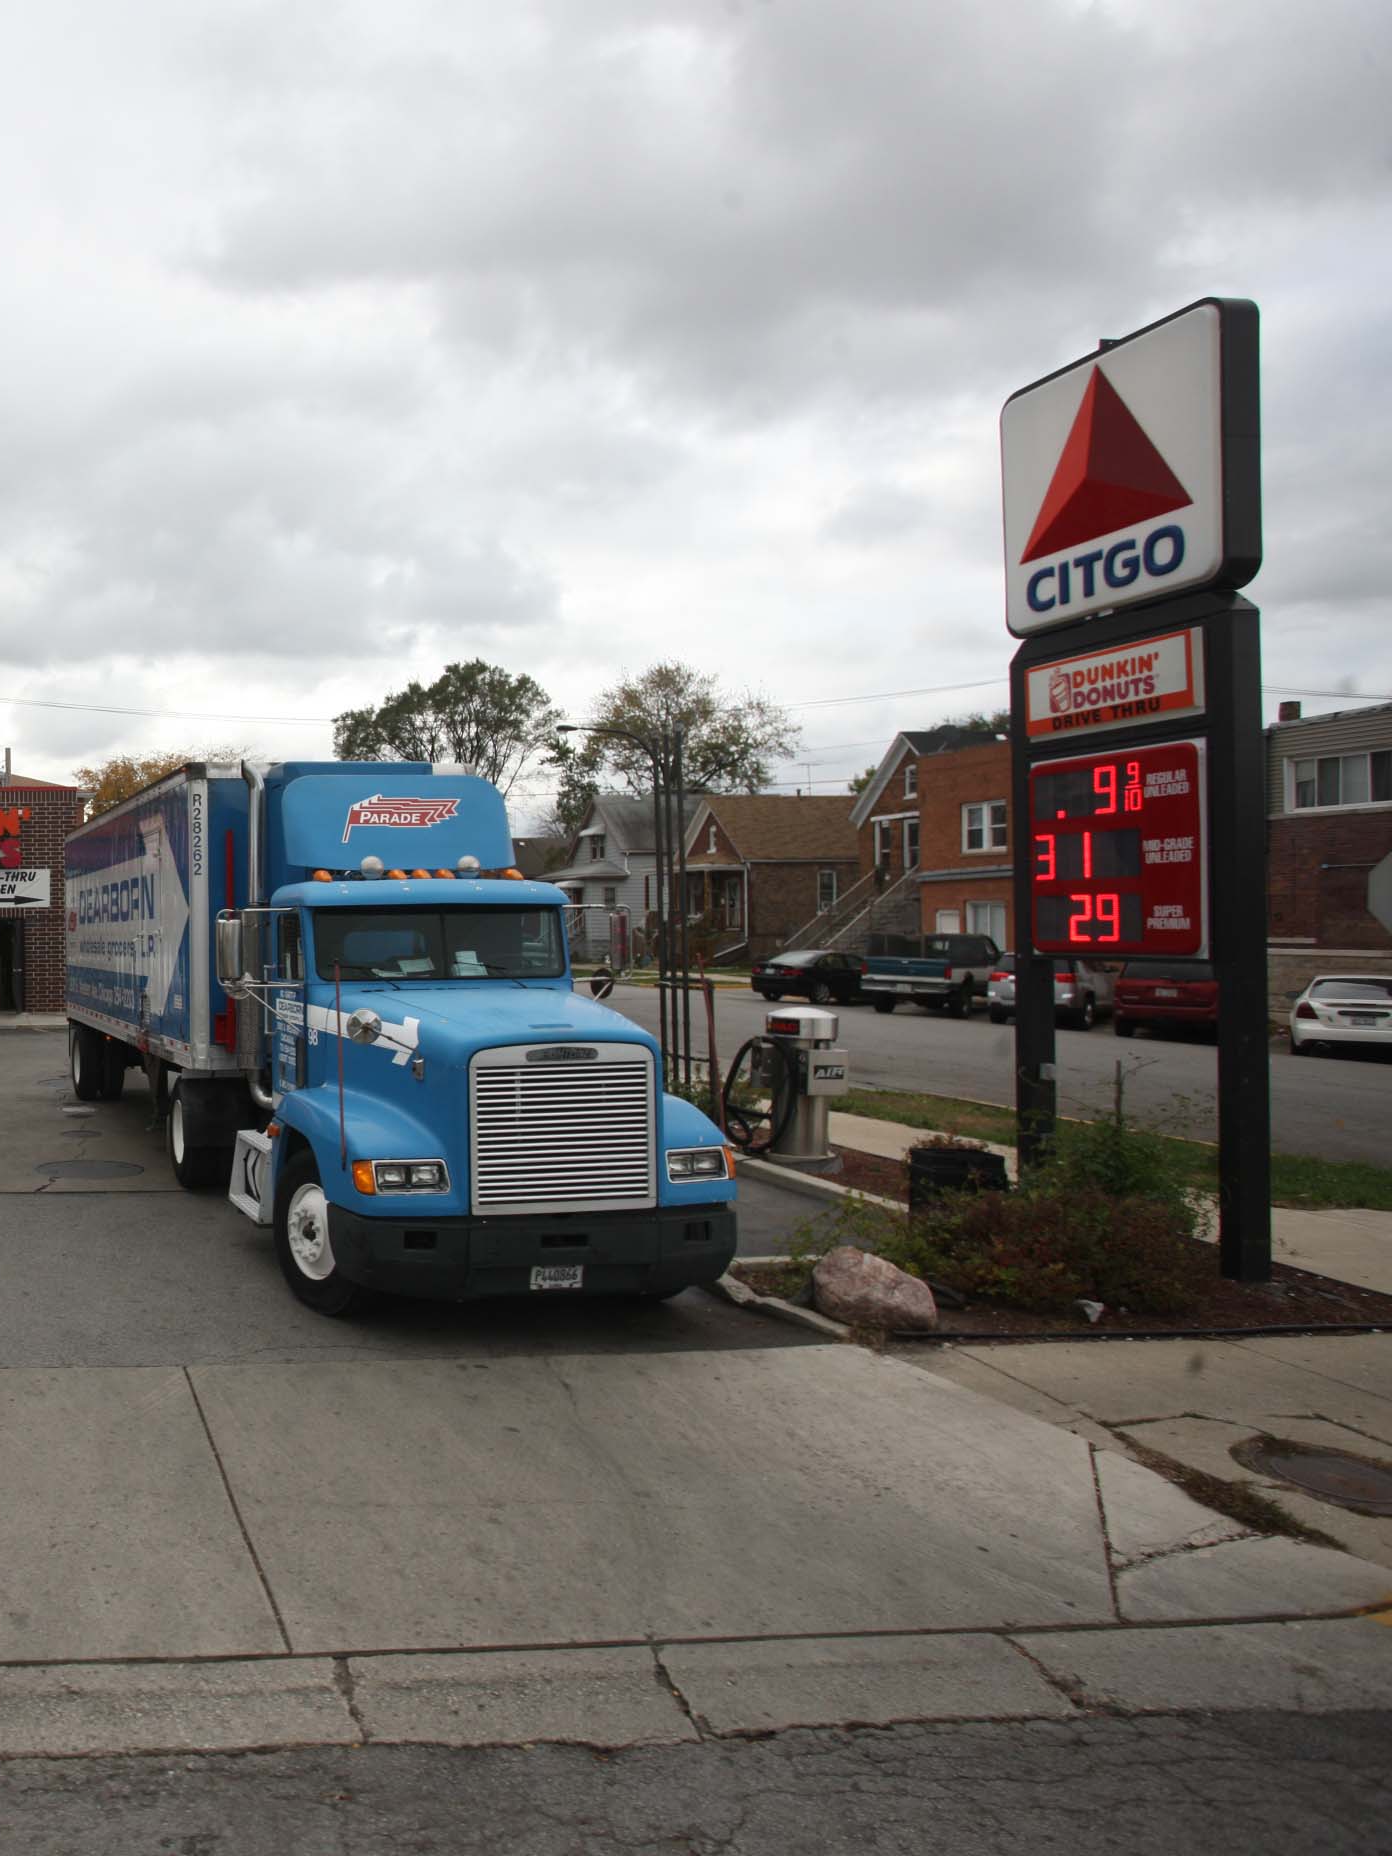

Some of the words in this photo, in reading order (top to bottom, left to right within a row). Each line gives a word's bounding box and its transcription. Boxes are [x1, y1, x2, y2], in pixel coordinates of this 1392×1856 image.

[1026, 525, 1185, 612] CITGO
[1072, 652, 1159, 689] DUNKIN'
[1072, 675, 1155, 709] DONUTS
[1052, 707, 1101, 731] DRIVE
[1112, 695, 1161, 719] THRU
[1145, 769, 1188, 786] REGULAR
[1144, 781, 1191, 798] UNLEADED
[360, 812, 422, 824] PARADE
[1143, 836, 1195, 852] MID-GRADE
[1145, 850, 1193, 864] UNLEADED
[79, 873, 155, 924] DEARBORN
[1070, 894, 1121, 942] 29
[1153, 905, 1184, 917] SUPER
[1147, 917, 1191, 929] PREMIUM
[308, 1029, 319, 1047] 98
[814, 1068, 844, 1079] AIR
